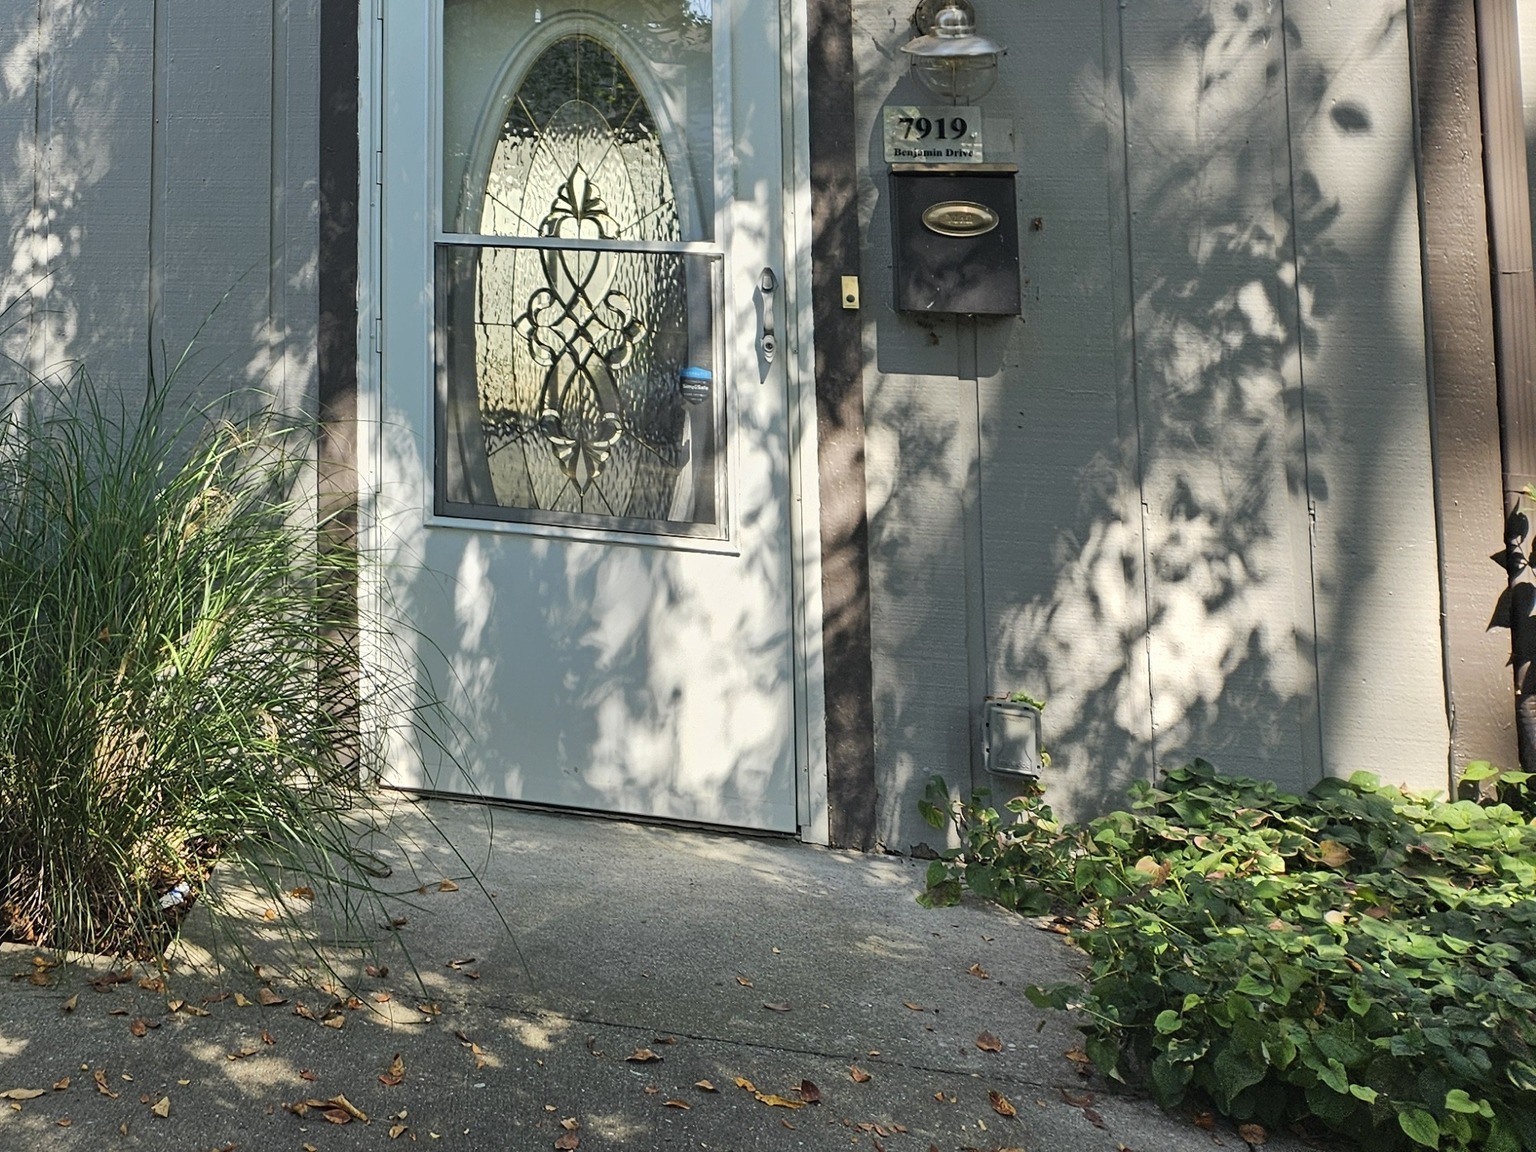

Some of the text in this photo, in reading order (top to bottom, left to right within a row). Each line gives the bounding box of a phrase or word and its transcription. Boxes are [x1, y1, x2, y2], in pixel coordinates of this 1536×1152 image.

[898, 117, 968, 140] 7919
[894, 148, 975, 159] Benjamin Drive
